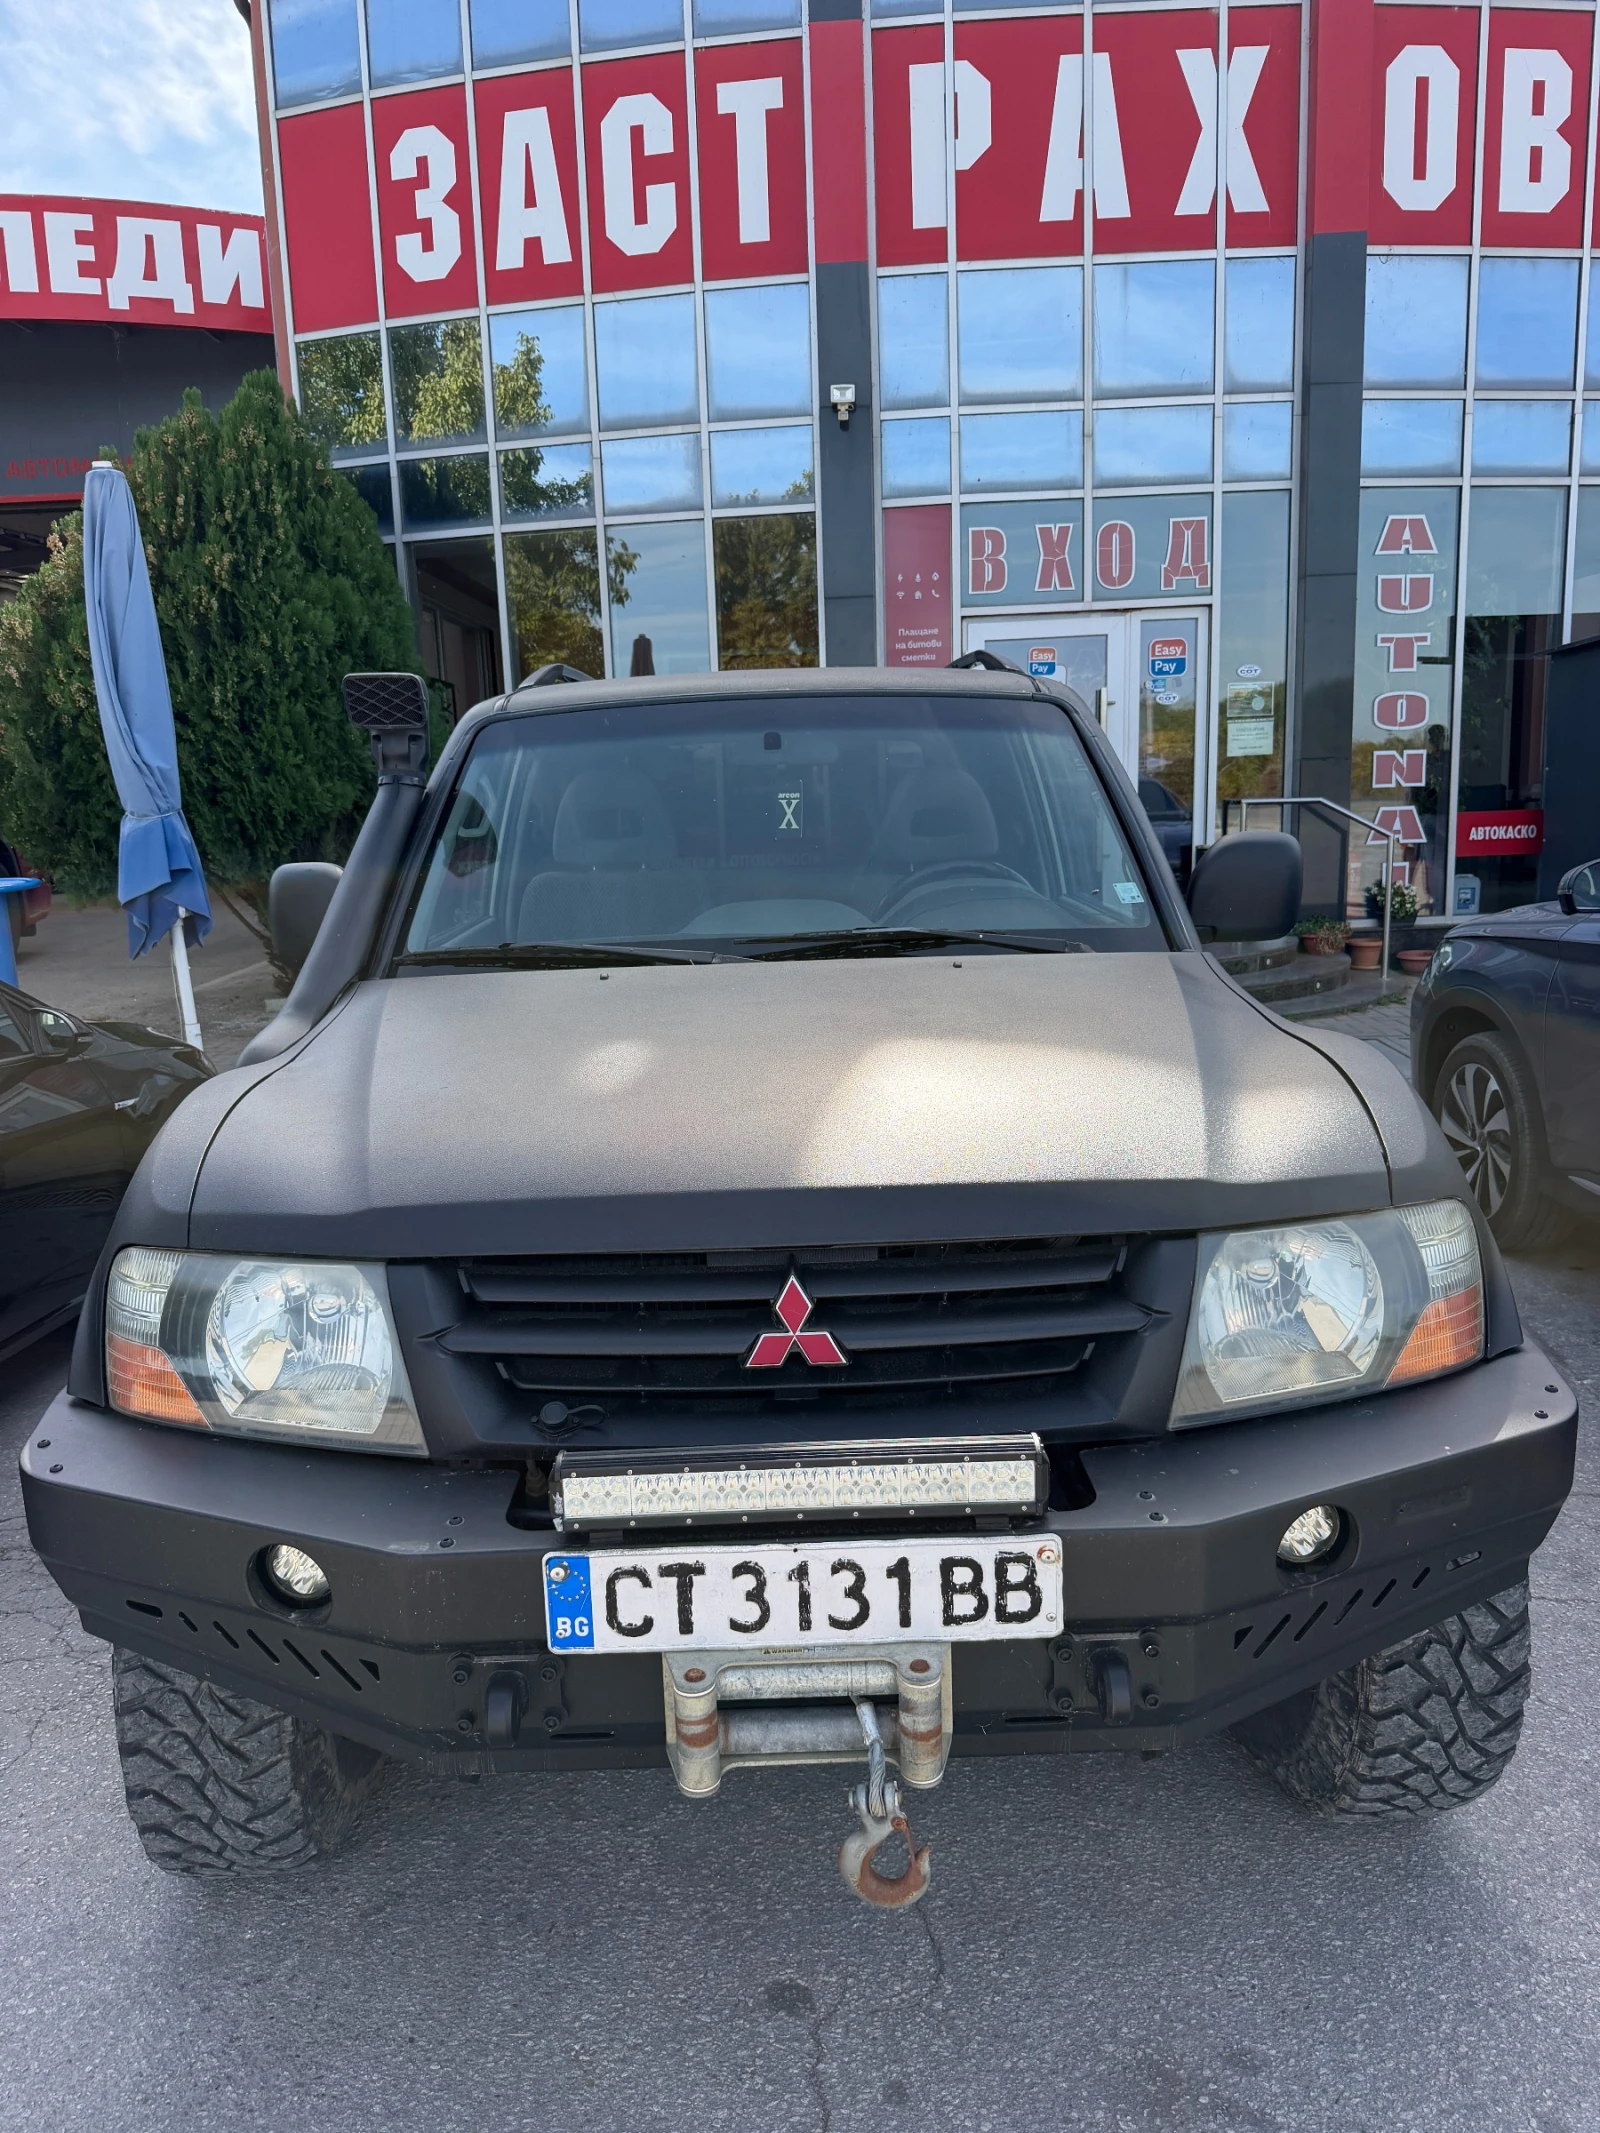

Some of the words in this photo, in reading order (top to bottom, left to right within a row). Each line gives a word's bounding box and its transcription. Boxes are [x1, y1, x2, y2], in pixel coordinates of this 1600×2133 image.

[969, 516, 1211, 595] ВХОД
[898, 628, 939, 637] Плащане
[907, 640, 942, 649] битови
[1154, 644, 1183, 656] Easy
[901, 653, 936, 662] сметки
[1032, 651, 1053, 661] Easy
[1032, 663, 1048, 674] Pay
[1154, 661, 1177, 673] Pay
[778, 799, 800, 829] X
[1469, 825, 1537, 841] АВТОКАСКО
[604, 1560, 706, 1637] CT
[729, 1556, 911, 1634] 3131
[939, 1553, 1043, 1625] BB
[556, 1616, 589, 1638] BG
